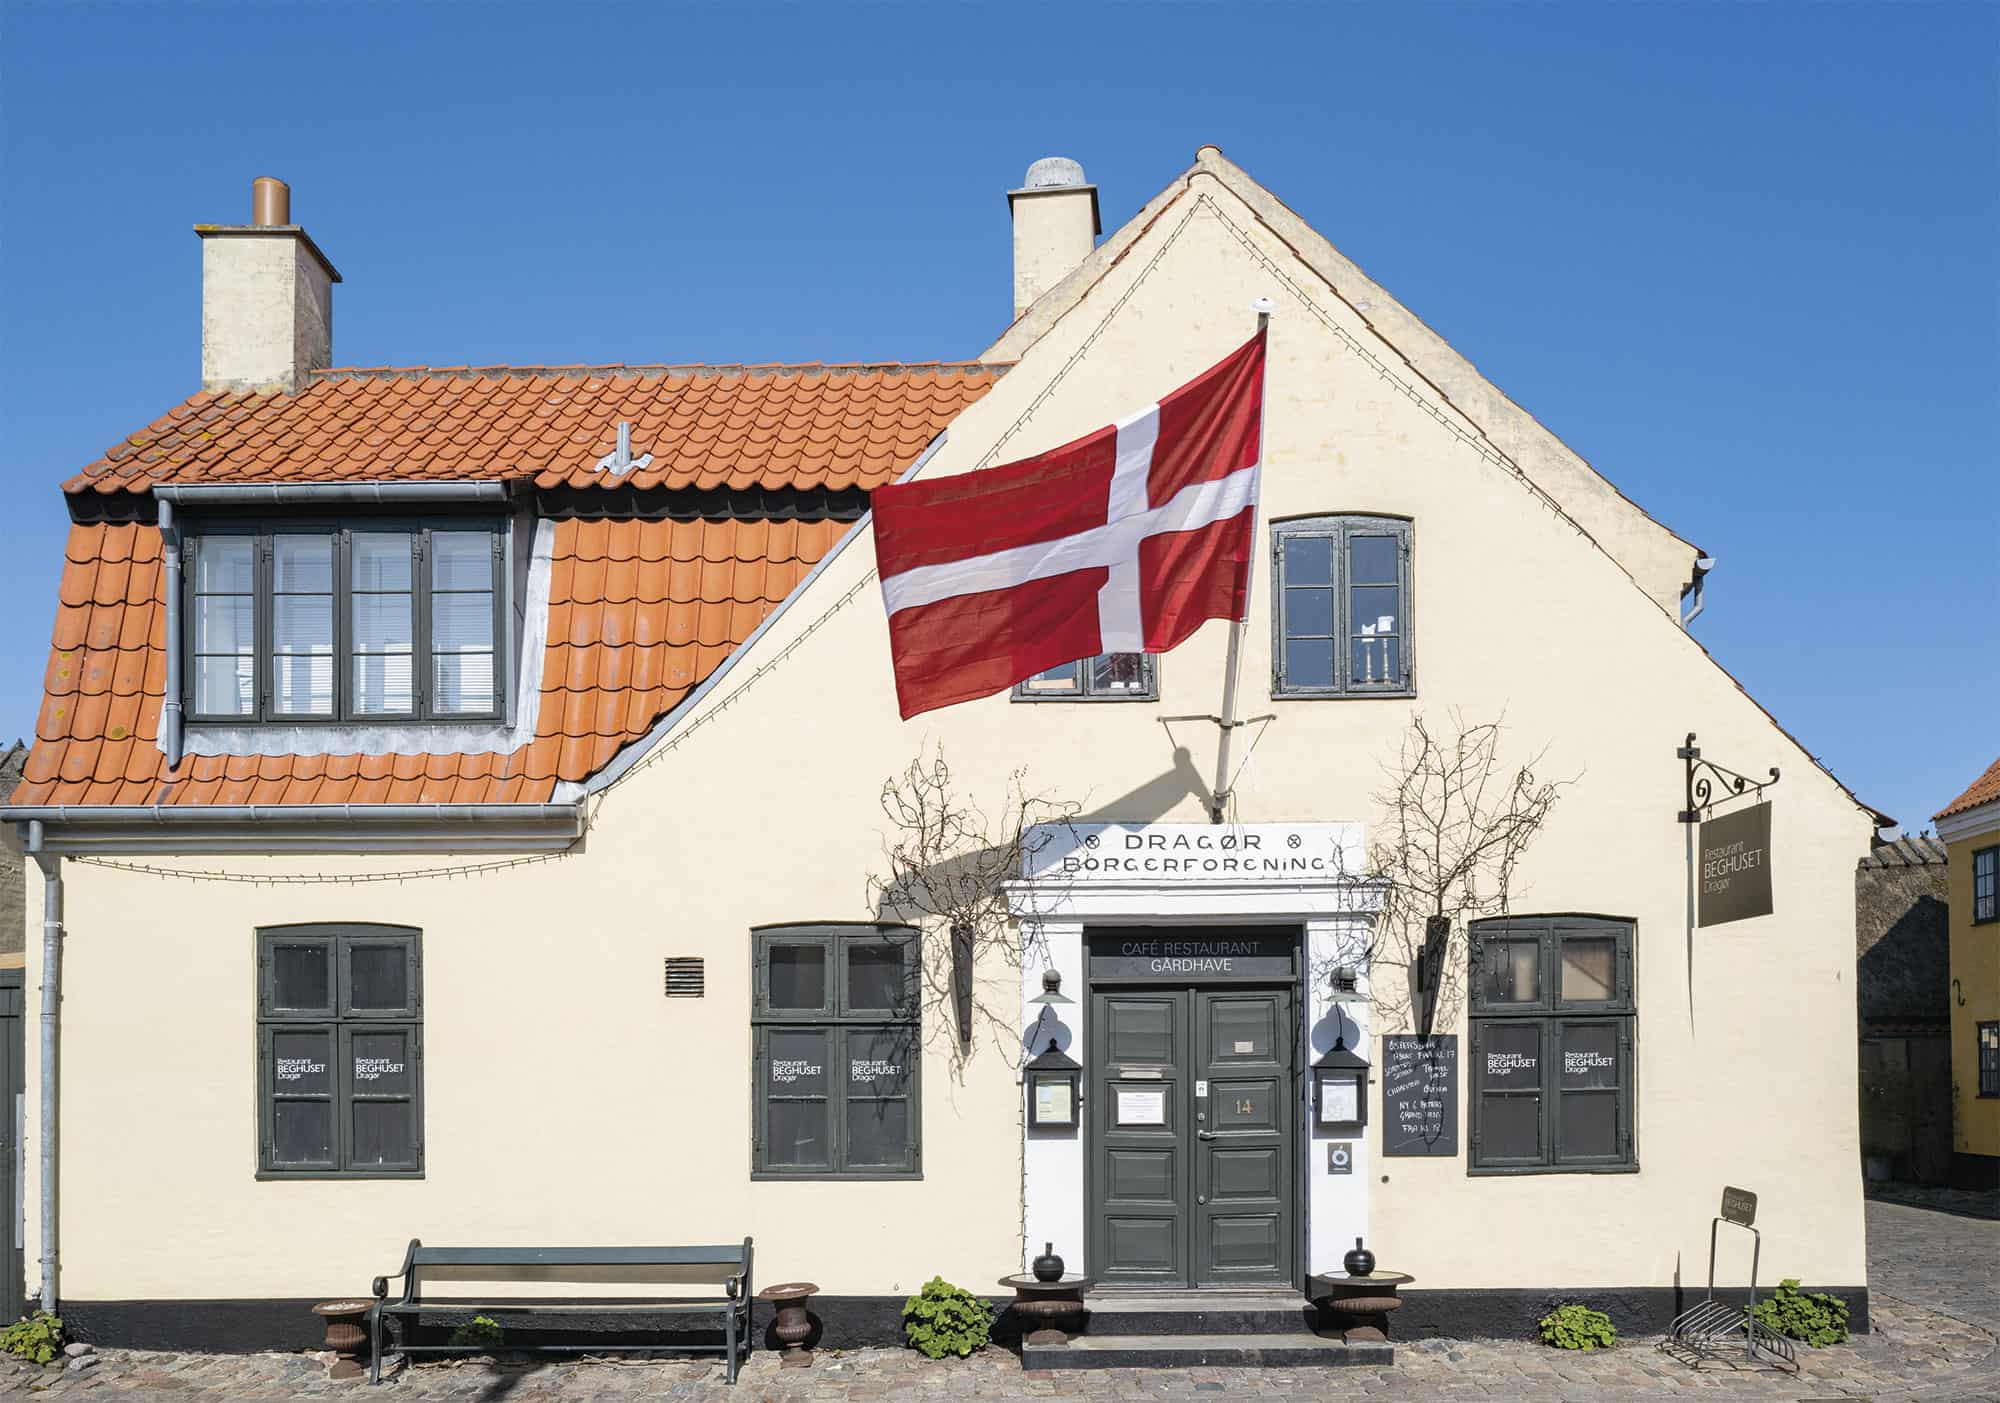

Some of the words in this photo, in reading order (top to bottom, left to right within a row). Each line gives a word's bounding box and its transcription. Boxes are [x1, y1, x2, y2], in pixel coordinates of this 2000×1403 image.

[1125, 834, 1262, 850] DRAGØR
[1704, 841, 1744, 861] Restaurant
[1704, 849, 1763, 879] BEGHUSET
[1121, 939, 1159, 955] CAFÉ
[1164, 942, 1260, 955] RESTAURANT
[1487, 1059, 1536, 1067] BEGHUSET
[1564, 1058, 1613, 1066] BEGHUSET
[278, 1064, 325, 1072] BEGHUSET
[356, 1064, 404, 1072] BEGHUSET
[773, 1066, 821, 1074] BEGHUSET
[852, 1066, 900, 1074] BEGHUSET
[1235, 1099, 1252, 1114] 14
